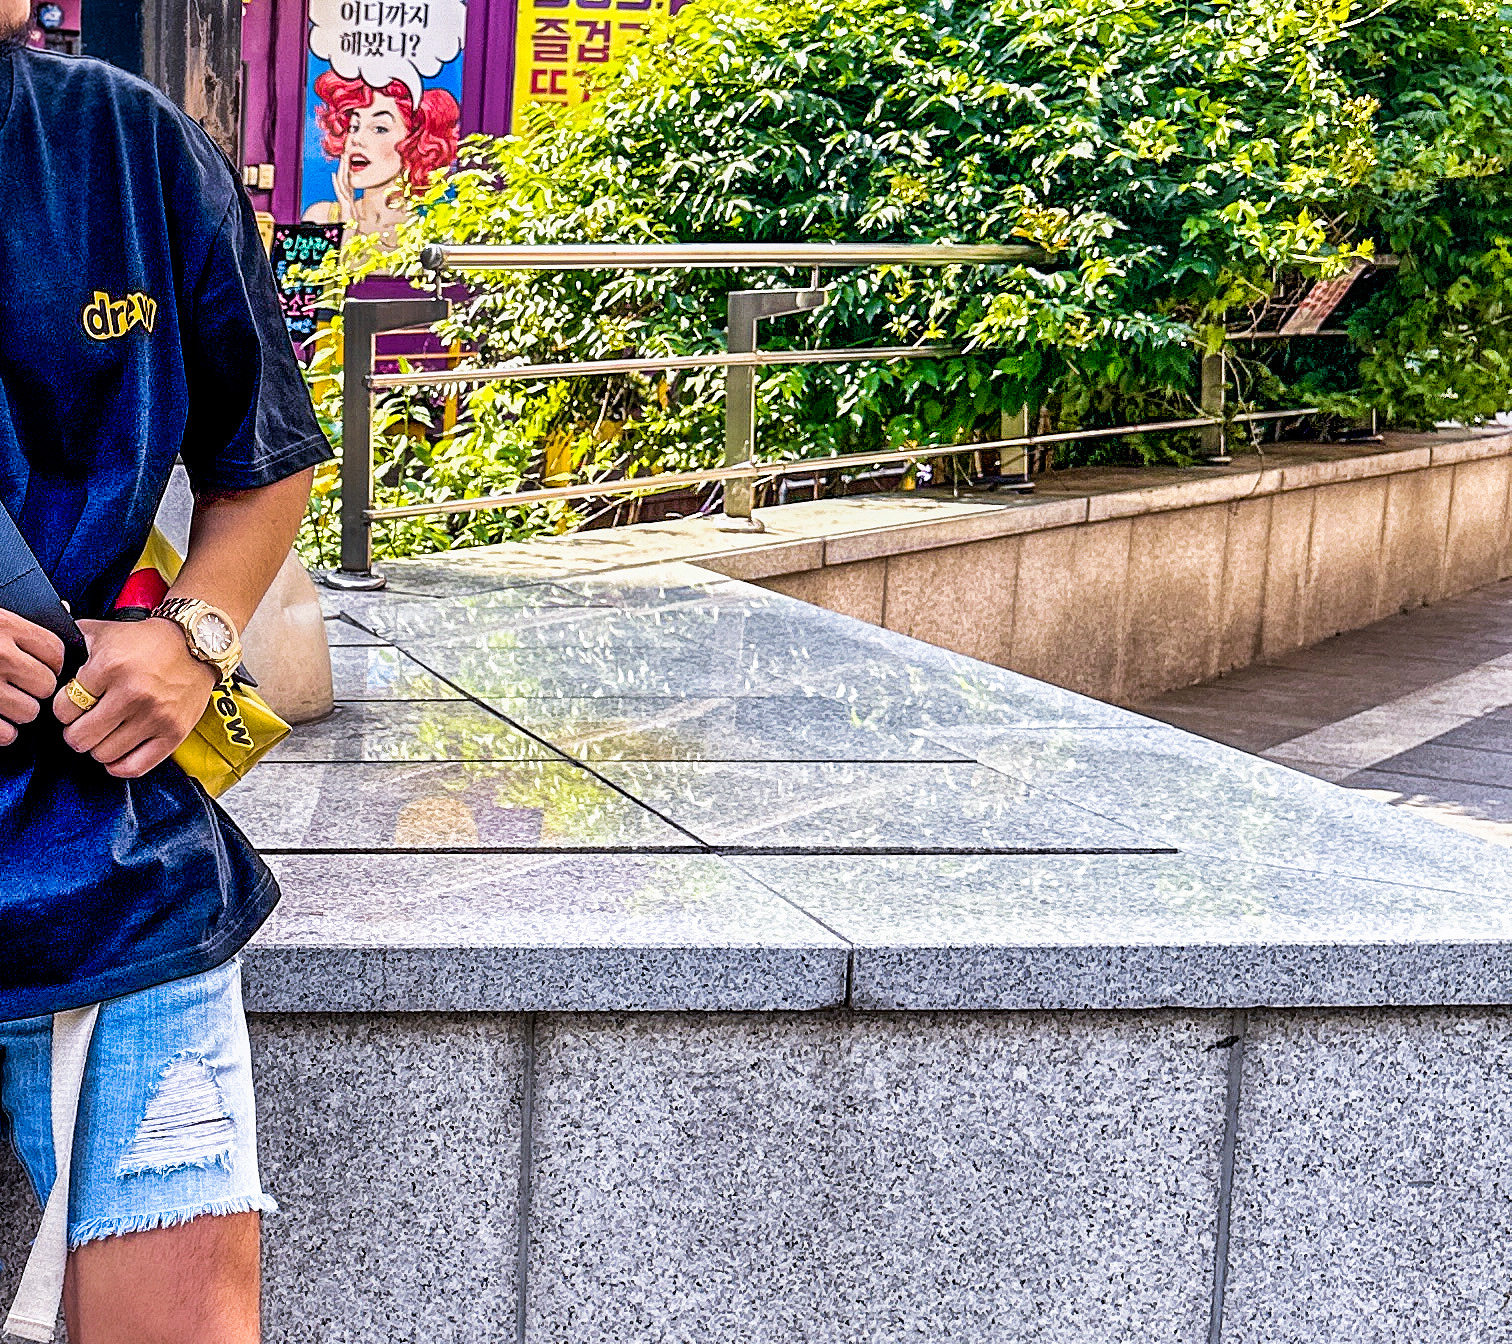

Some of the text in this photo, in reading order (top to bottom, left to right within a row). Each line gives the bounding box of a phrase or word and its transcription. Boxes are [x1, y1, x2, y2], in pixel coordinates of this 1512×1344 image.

[340, 0, 430, 29] 어디까지
[339, 30, 421, 58] 해봤니?
[83, 291, 157, 340] drew
